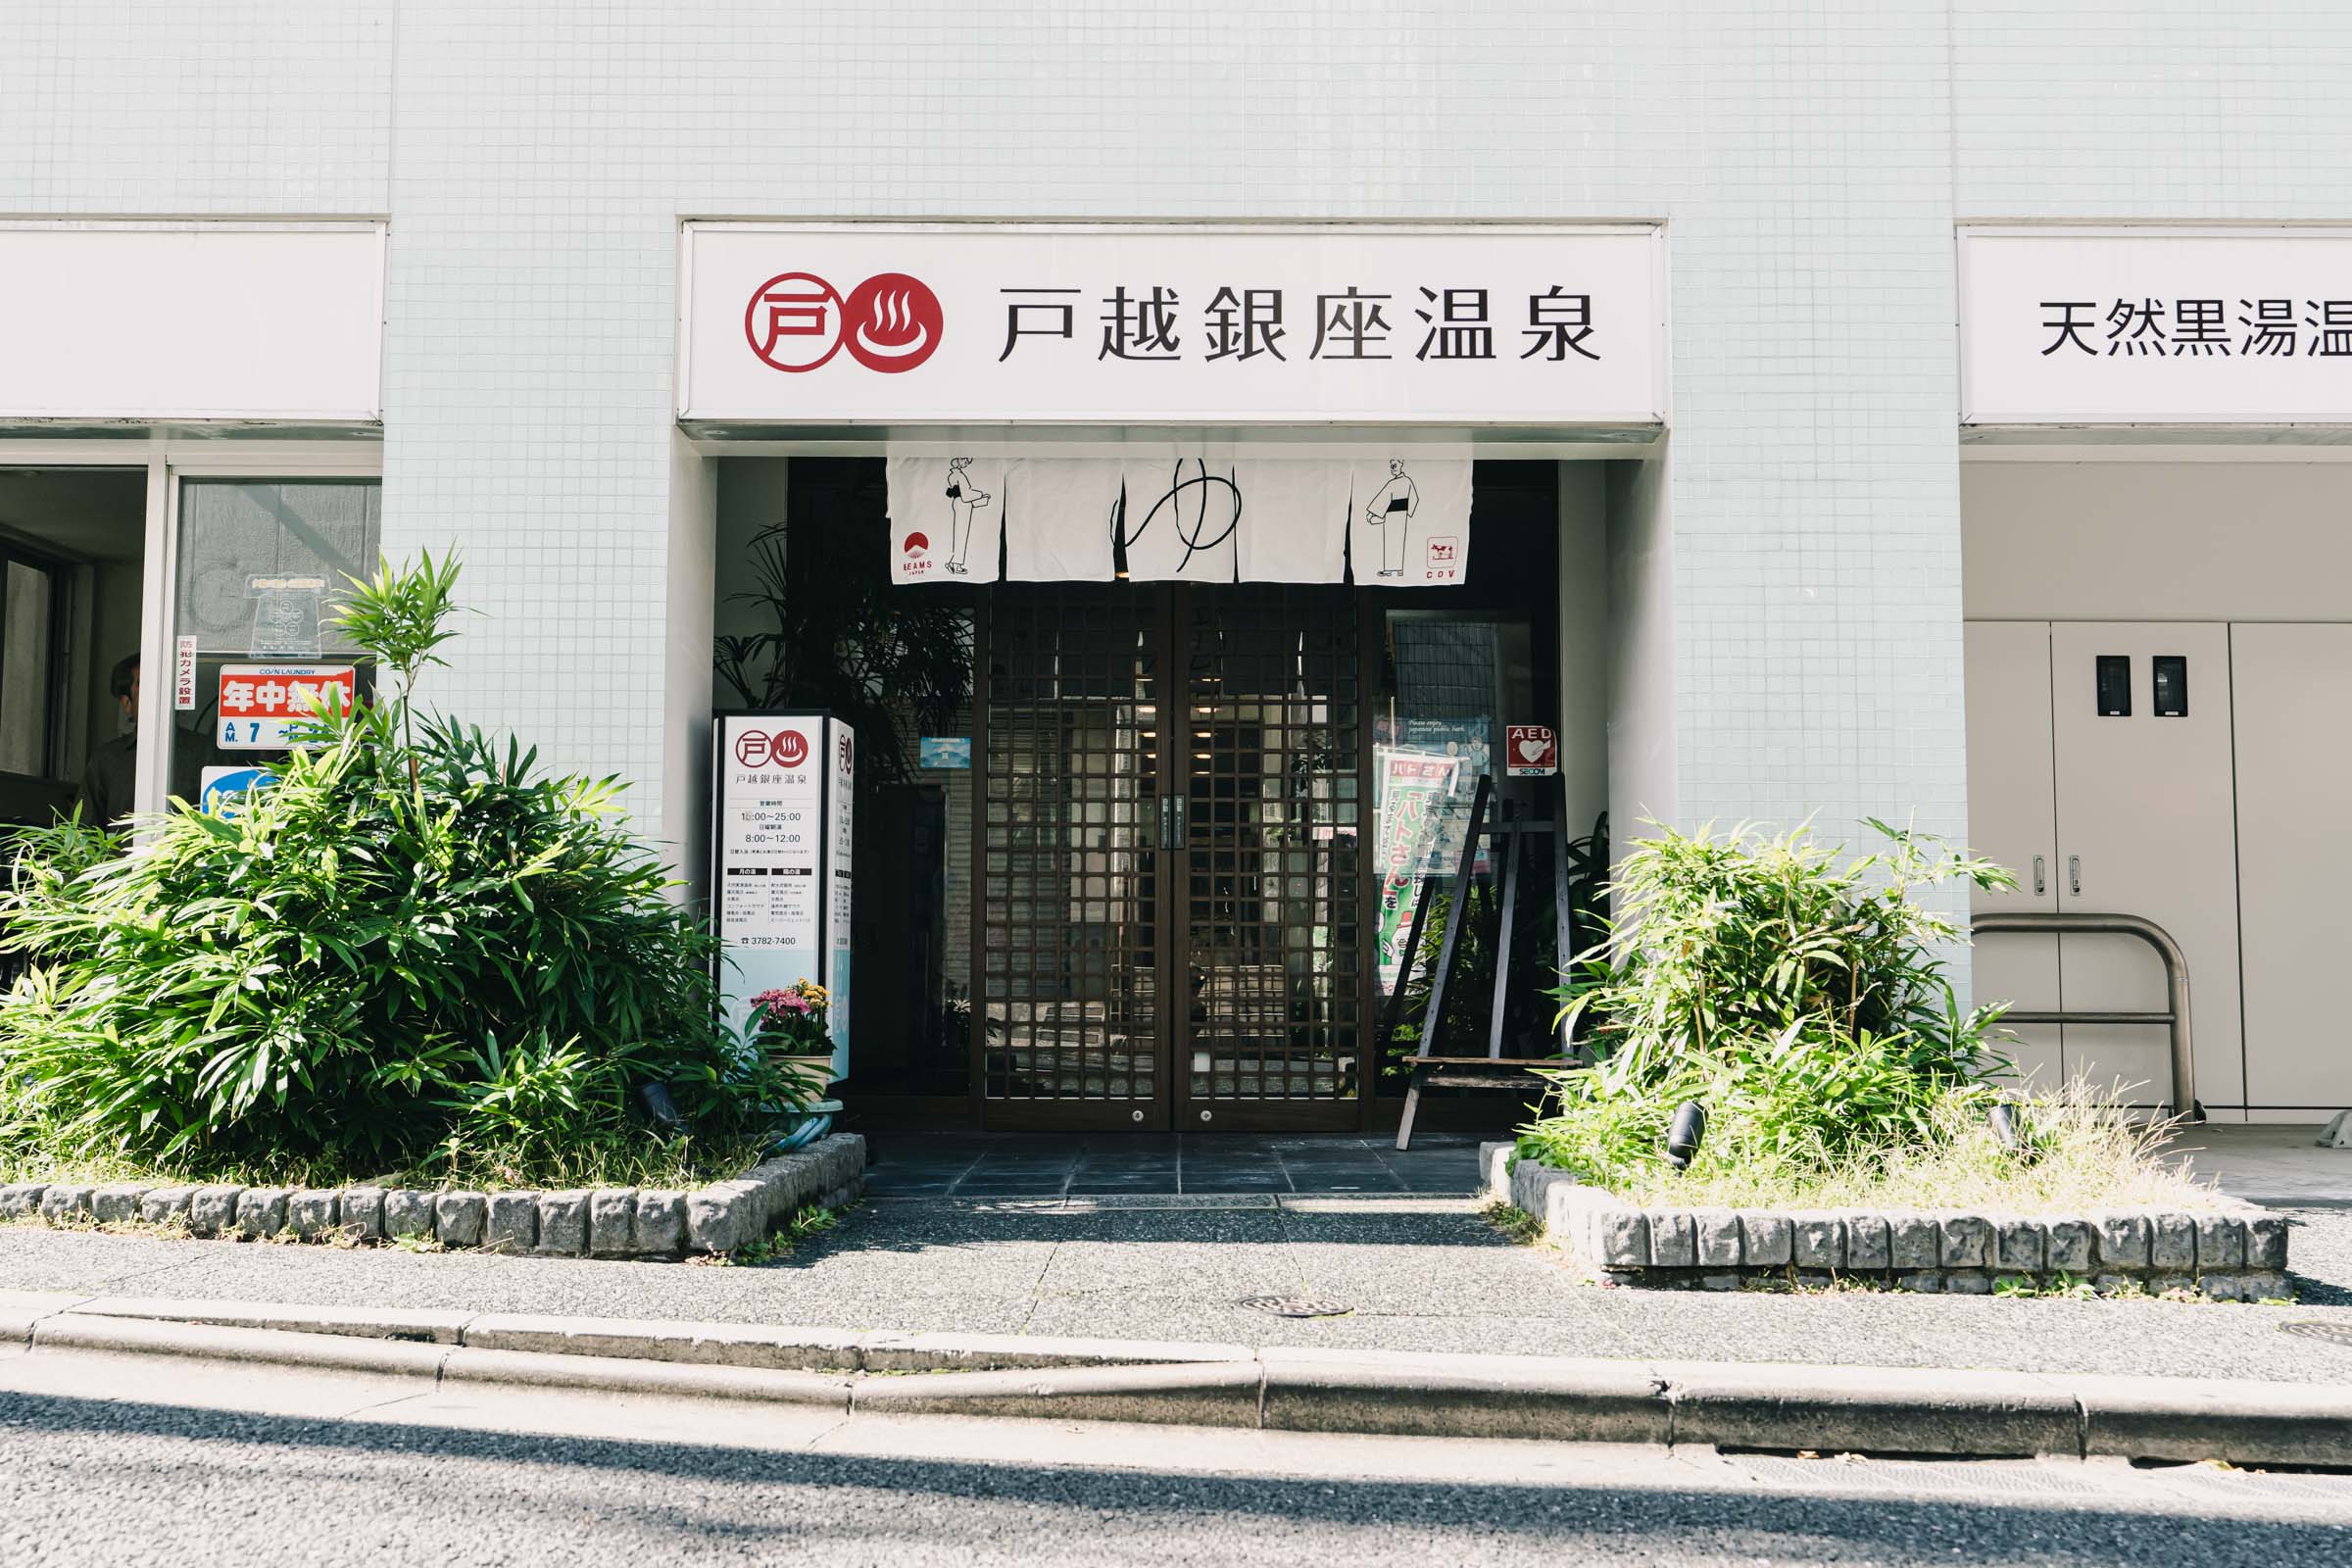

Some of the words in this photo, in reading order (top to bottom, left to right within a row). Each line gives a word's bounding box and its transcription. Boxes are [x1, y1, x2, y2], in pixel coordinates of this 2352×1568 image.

[999, 284, 1601, 362] 戸越銀座温泉
[2039, 297, 2352, 357] 天然黒湯温
[179, 640, 193, 705] 防犯カメラ設置
[222, 680, 352, 712] 年中無休
[1511, 728, 1552, 739] AED
[736, 773, 807, 785] 戸越銀座温泉
